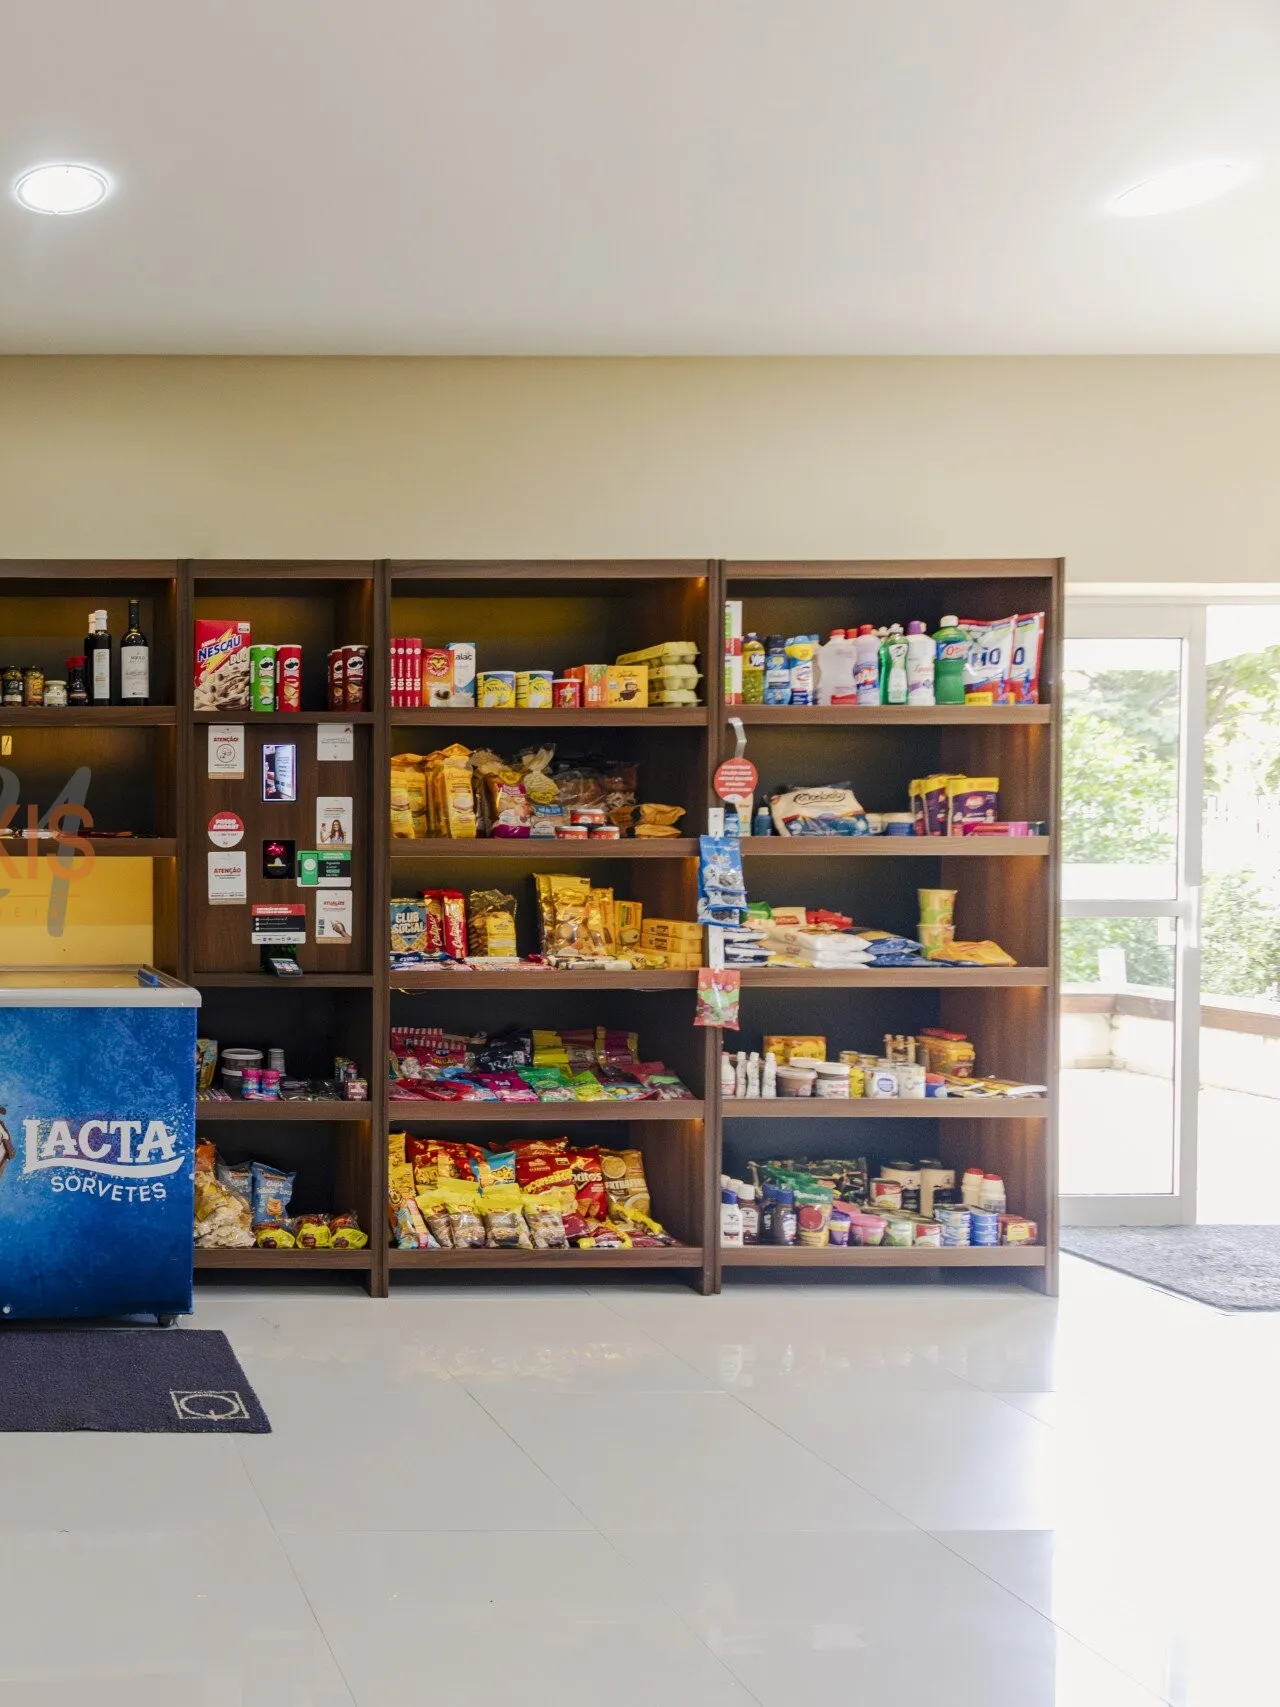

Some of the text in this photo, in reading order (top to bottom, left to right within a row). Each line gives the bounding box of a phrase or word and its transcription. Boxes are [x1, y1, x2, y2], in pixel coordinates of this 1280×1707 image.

[197, 634, 241, 662] NESCAU
[391, 922, 426, 934] SOCIAL
[396, 912, 419, 923] CLUB
[22, 1119, 184, 1177] LACTA
[50, 1175, 167, 1202] SORVETES
